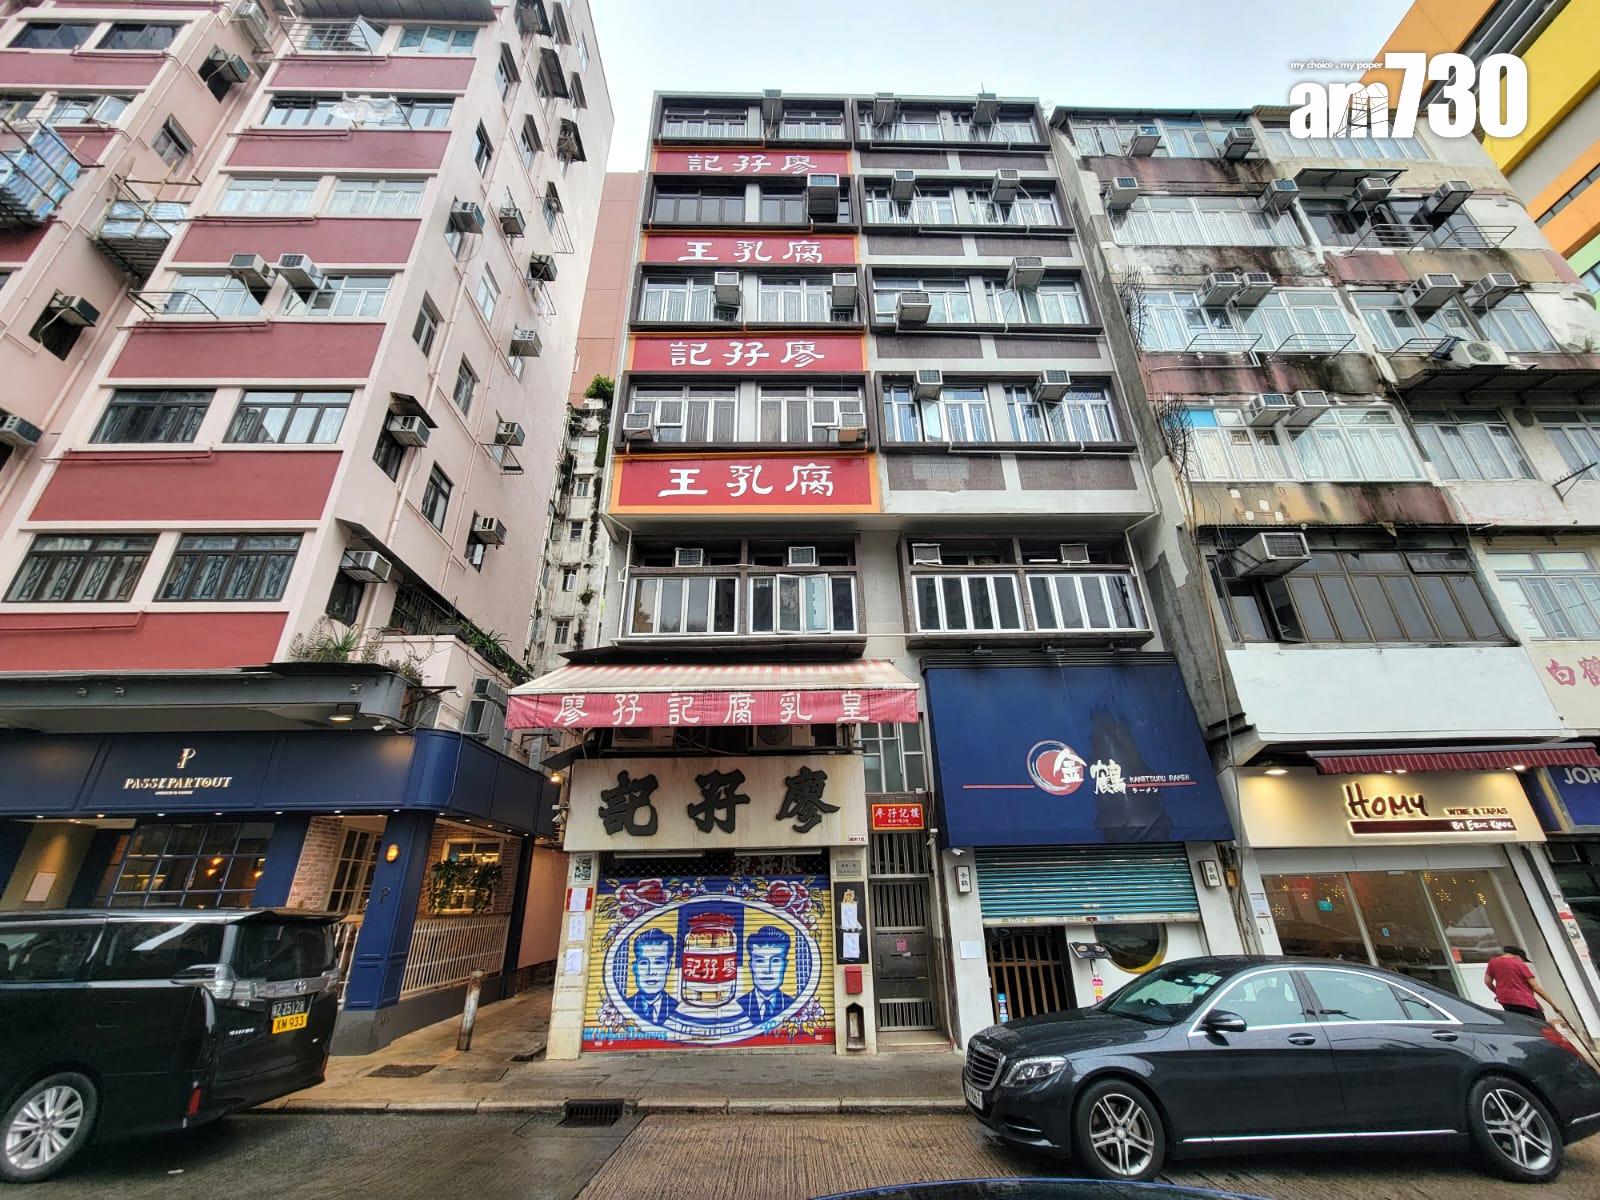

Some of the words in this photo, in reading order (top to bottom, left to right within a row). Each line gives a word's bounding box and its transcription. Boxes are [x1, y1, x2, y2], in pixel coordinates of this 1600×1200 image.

[553, 692, 871, 726] 廖孖記腐乳皇
[122, 776, 233, 790] PASSEPARTOUT
[1481, 807, 1508, 815] TAPAS
[289, 1015, 305, 1028] 933
